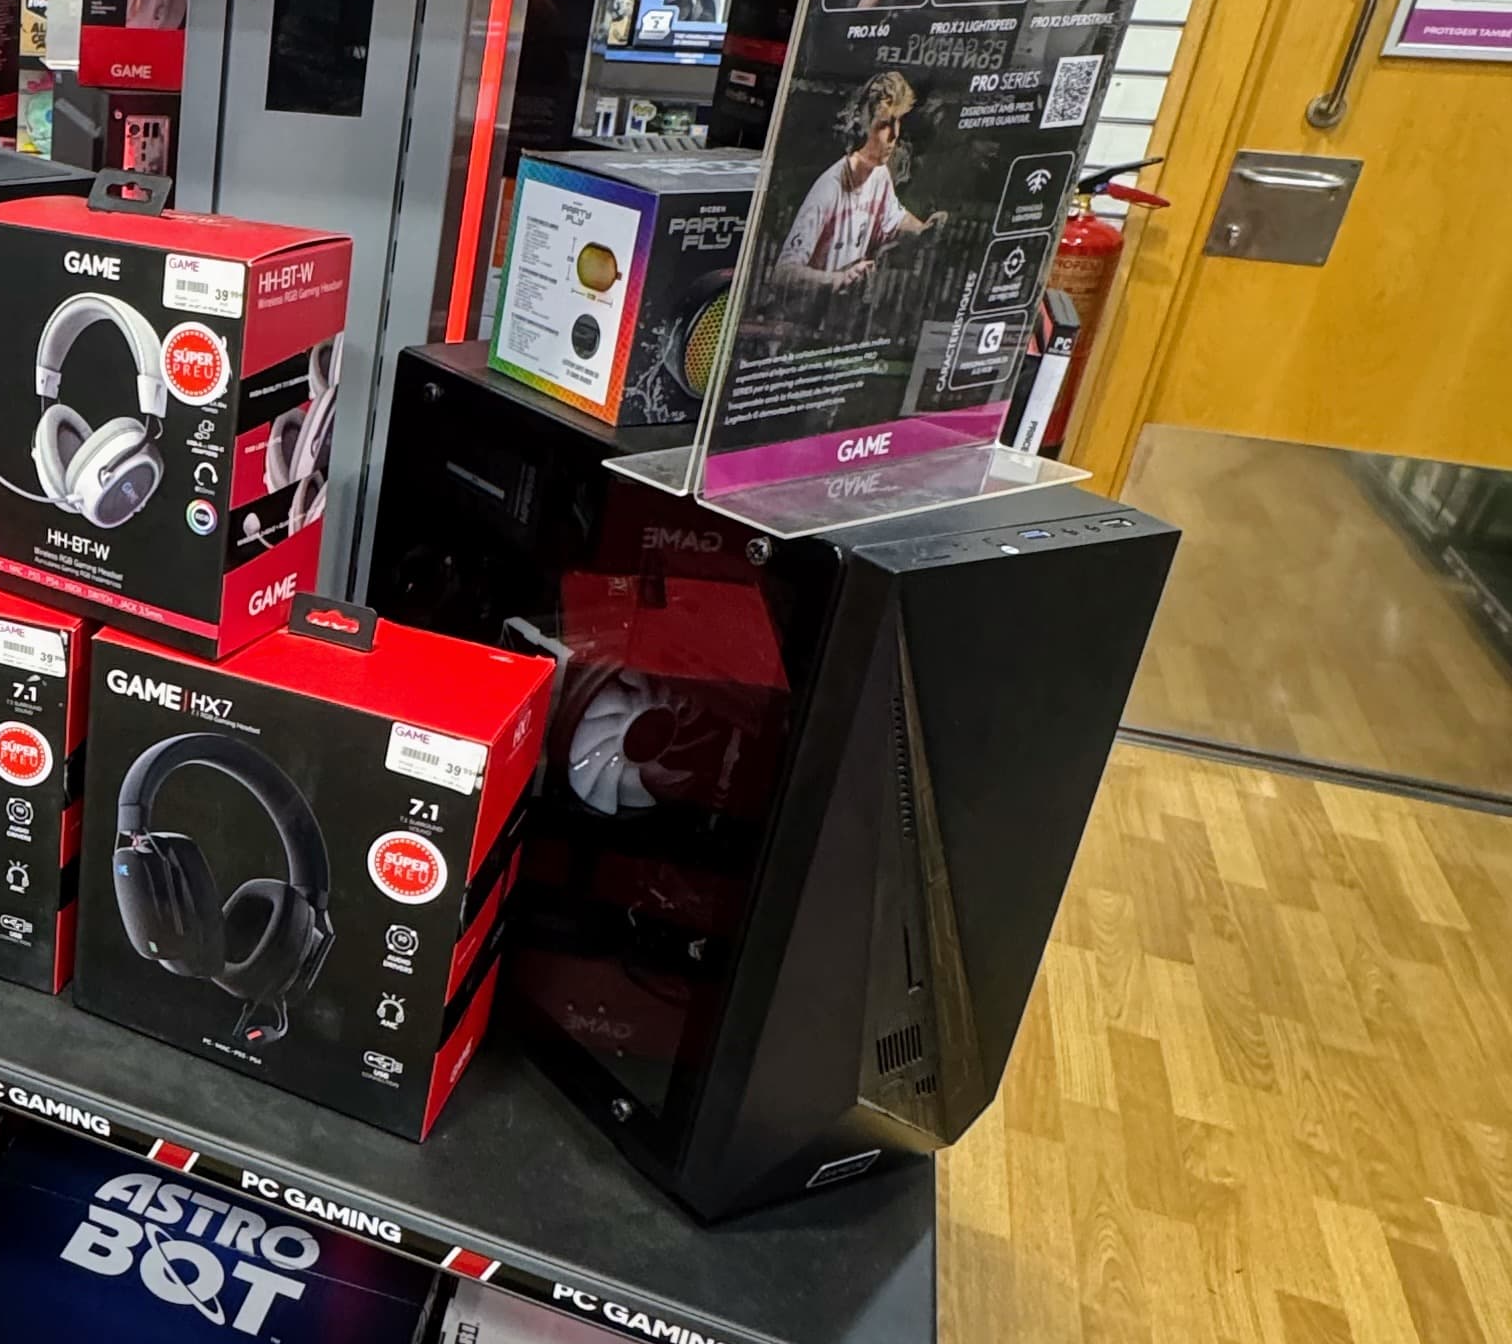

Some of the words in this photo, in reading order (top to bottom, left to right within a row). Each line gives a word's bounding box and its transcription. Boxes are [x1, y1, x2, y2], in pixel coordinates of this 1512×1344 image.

[847, 27, 866, 39] PRO
[110, 64, 152, 80] GAME
[970, 74, 998, 93] PRO
[999, 71, 1041, 90] SERIES
[668, 216, 746, 236] PARTY
[681, 233, 733, 252] FLY
[64, 251, 122, 282] GAME
[168, 258, 200, 272] GAME
[258, 261, 315, 295] HH-BT-W
[215, 289, 229, 302] 39
[1054, 336, 1073, 351] PC
[173, 347, 214, 367] SÚPER
[173, 363, 215, 380] PREU
[837, 432, 893, 463] GAME
[47, 528, 111, 561] HH-BT-W
[59, 553, 74, 566] RGB
[119, 597, 138, 613] JACK
[248, 573, 297, 617] GAME
[40, 652, 53, 663] 39
[12, 682, 37, 703] 7.1
[107, 669, 183, 711] GAME
[190, 691, 233, 719] HX7
[395, 725, 432, 745] GAME
[1, 738, 39, 758] SÚPER
[0, 752, 38, 768] PREU
[445, 763, 462, 777] 39
[409, 798, 439, 822] 7.1
[384, 852, 430, 873] SÚPER
[382, 863, 430, 885] PREU
[8, 1086, 112, 1138] GAMING
[241, 1169, 279, 1201] PC
[283, 1186, 403, 1246] GAMING
[552, 1281, 598, 1313] PC
[93, 1172, 321, 1272] ASTRO
[59, 1203, 307, 1338] BOT
